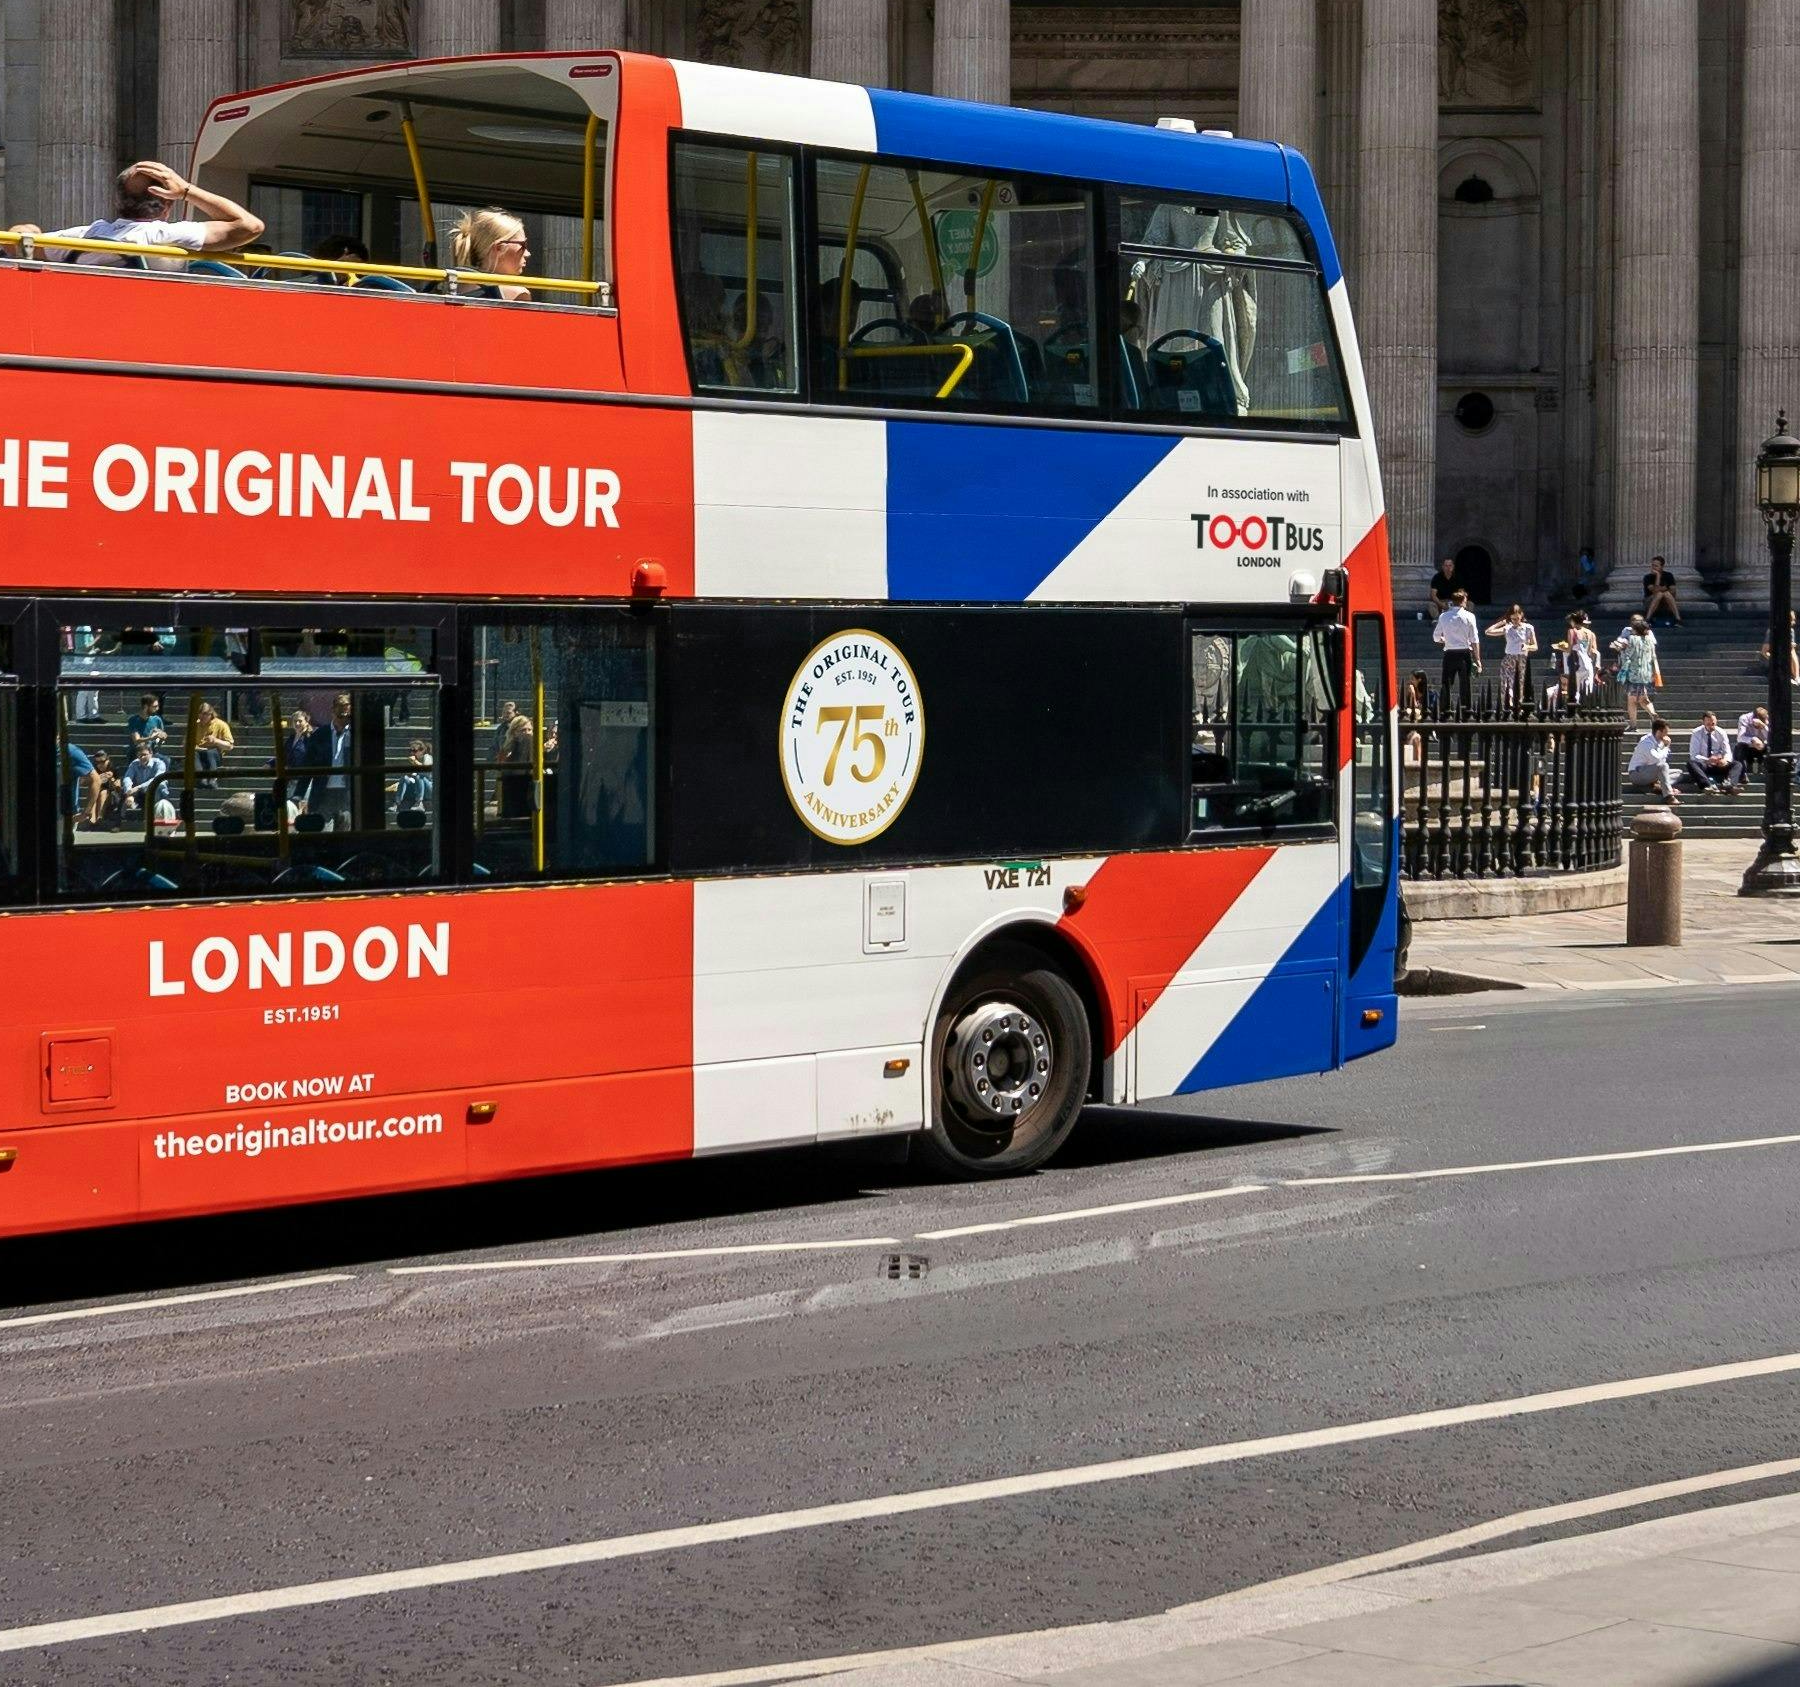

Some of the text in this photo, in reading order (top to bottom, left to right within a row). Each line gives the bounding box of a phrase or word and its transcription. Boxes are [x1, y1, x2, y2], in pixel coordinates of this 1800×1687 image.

[92, 443, 431, 522] ORIGINAL
[450, 461, 621, 528] TOUR
[1207, 485, 1310, 502] In association with
[1237, 556, 1281, 568] LONDON
[791, 644, 916, 729] THE ORIGINAL TOUR
[834, 669, 878, 686] EST. 1951
[816, 704, 899, 787] 75th
[803, 781, 901, 829] ANNIVERSARY
[983, 865, 1051, 890] VXE 721
[149, 922, 450, 997] LONDON
[264, 1004, 340, 1025] EST.1951
[226, 1073, 375, 1103] BOOK NOW AT
[154, 1113, 443, 1159] theoriginaltour.com
